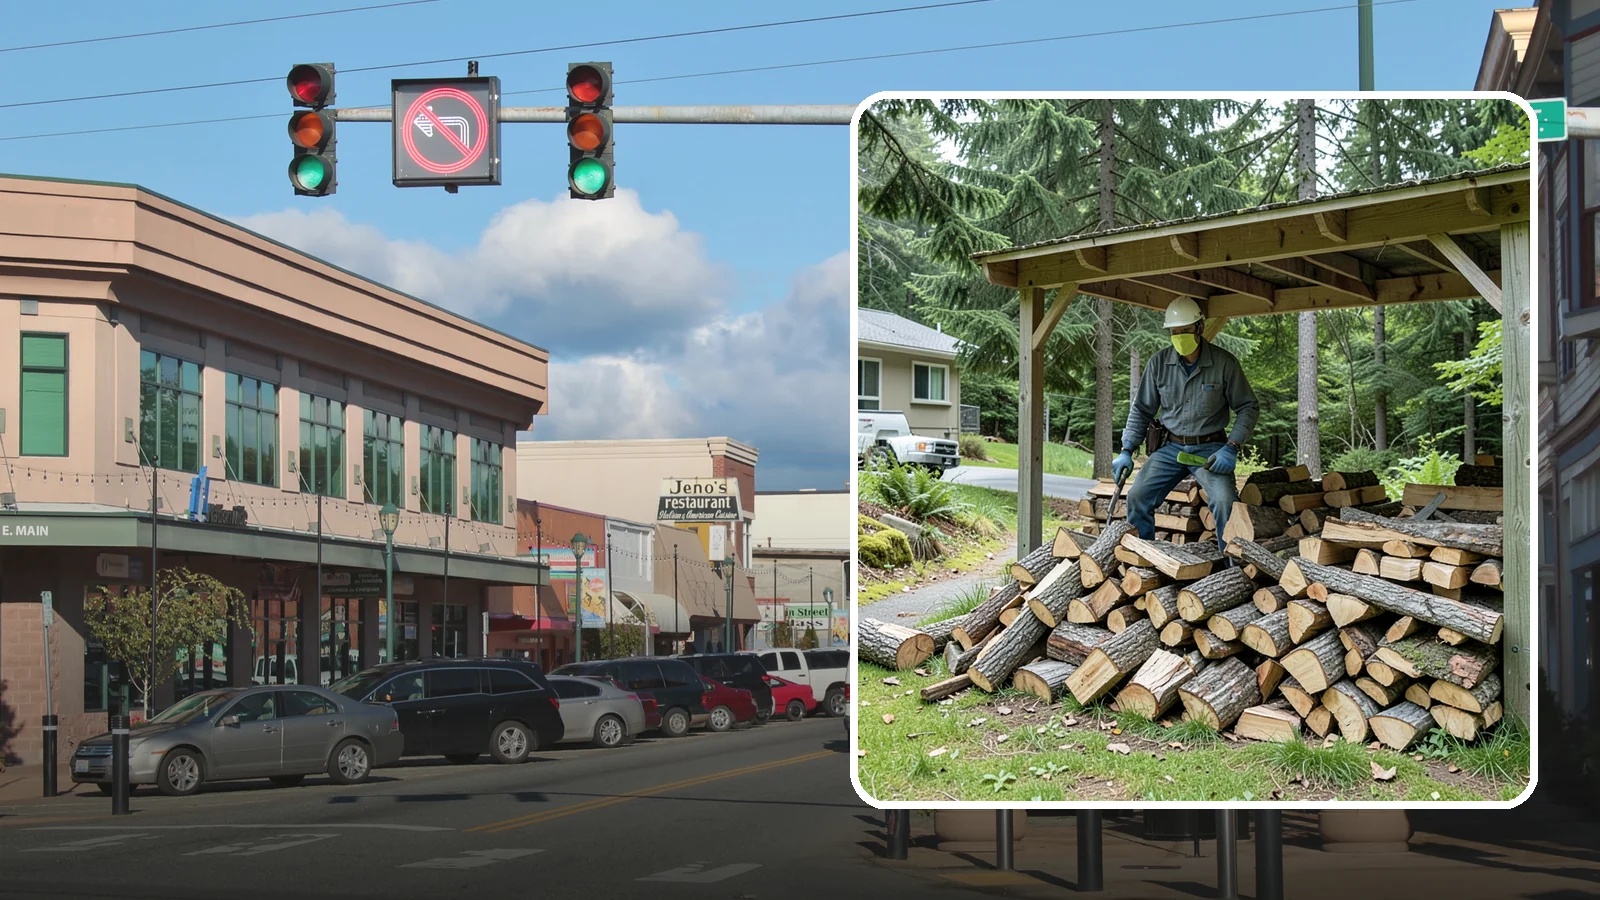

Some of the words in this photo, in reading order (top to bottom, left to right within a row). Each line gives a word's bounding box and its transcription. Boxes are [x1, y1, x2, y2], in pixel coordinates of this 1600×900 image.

[670, 480, 727, 494] Jeno's
[665, 496, 731, 509] restaurant
[659, 510, 681, 519] Italian
[686, 510, 714, 519] American
[715, 510, 737, 519] Cuisine
[2, 525, 13, 536] E.
[15, 525, 49, 536] MAIN
[797, 607, 828, 616] Street
